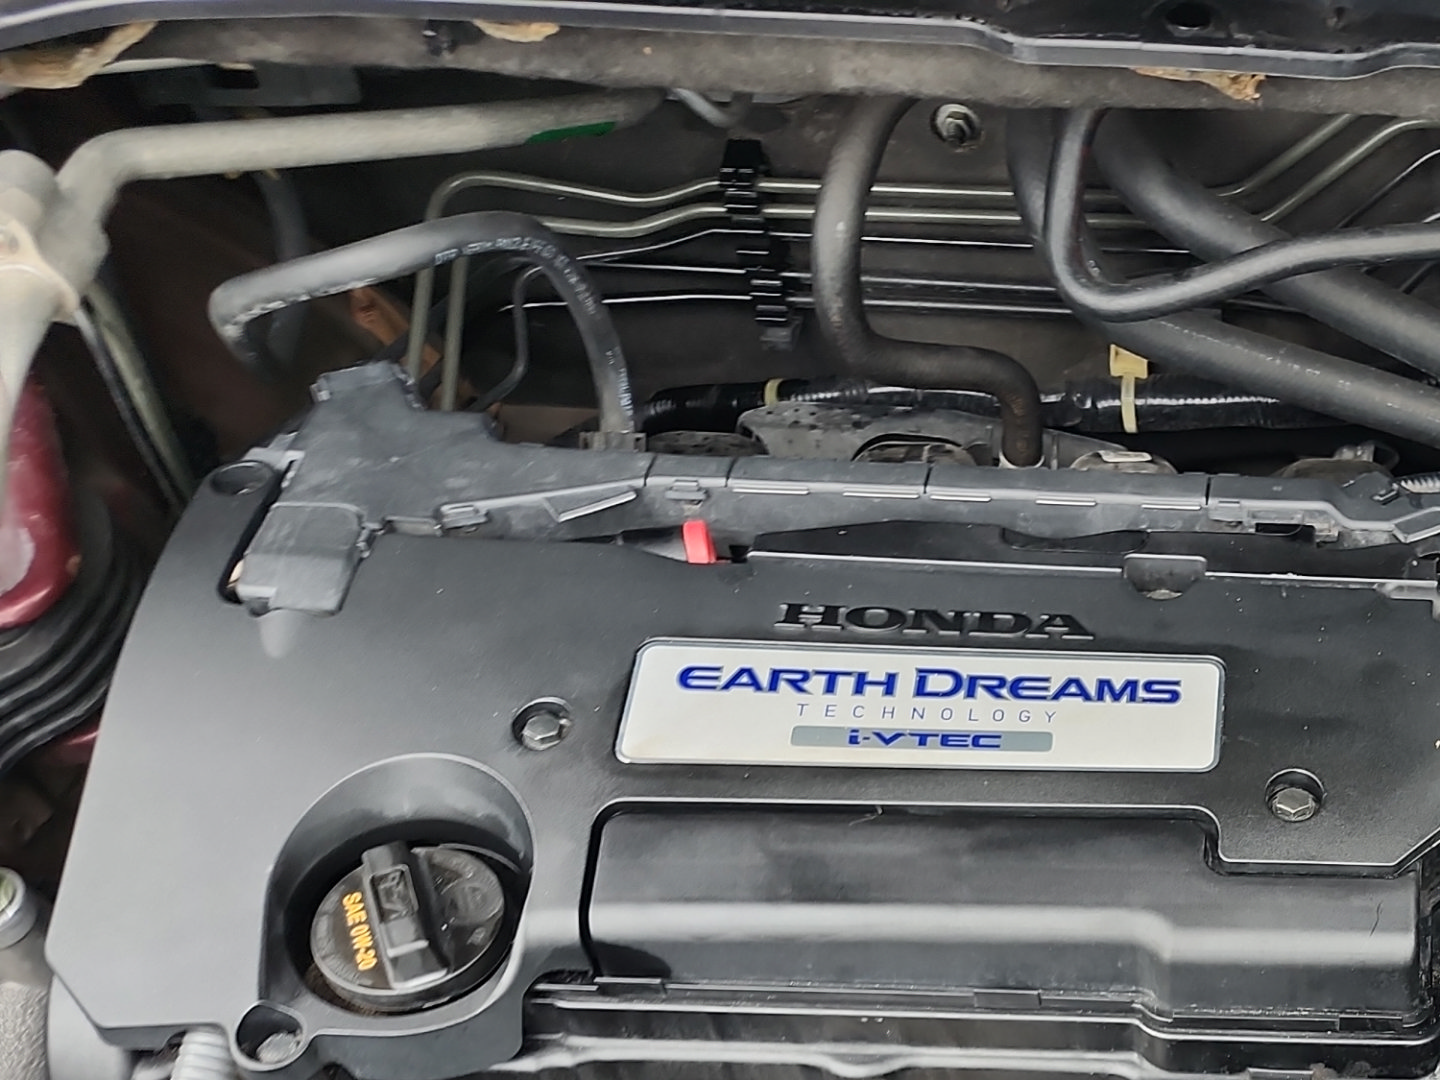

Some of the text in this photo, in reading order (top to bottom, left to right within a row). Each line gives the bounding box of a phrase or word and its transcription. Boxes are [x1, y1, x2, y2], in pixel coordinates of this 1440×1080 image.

[774, 603, 1095, 639] HONDA
[678, 665, 1182, 704] EARTH DREAMS
[797, 703, 1058, 723] TECHNOLOGY
[847, 729, 1003, 749] i-VTEC
[342, 891, 378, 972] SAE 0W-20
